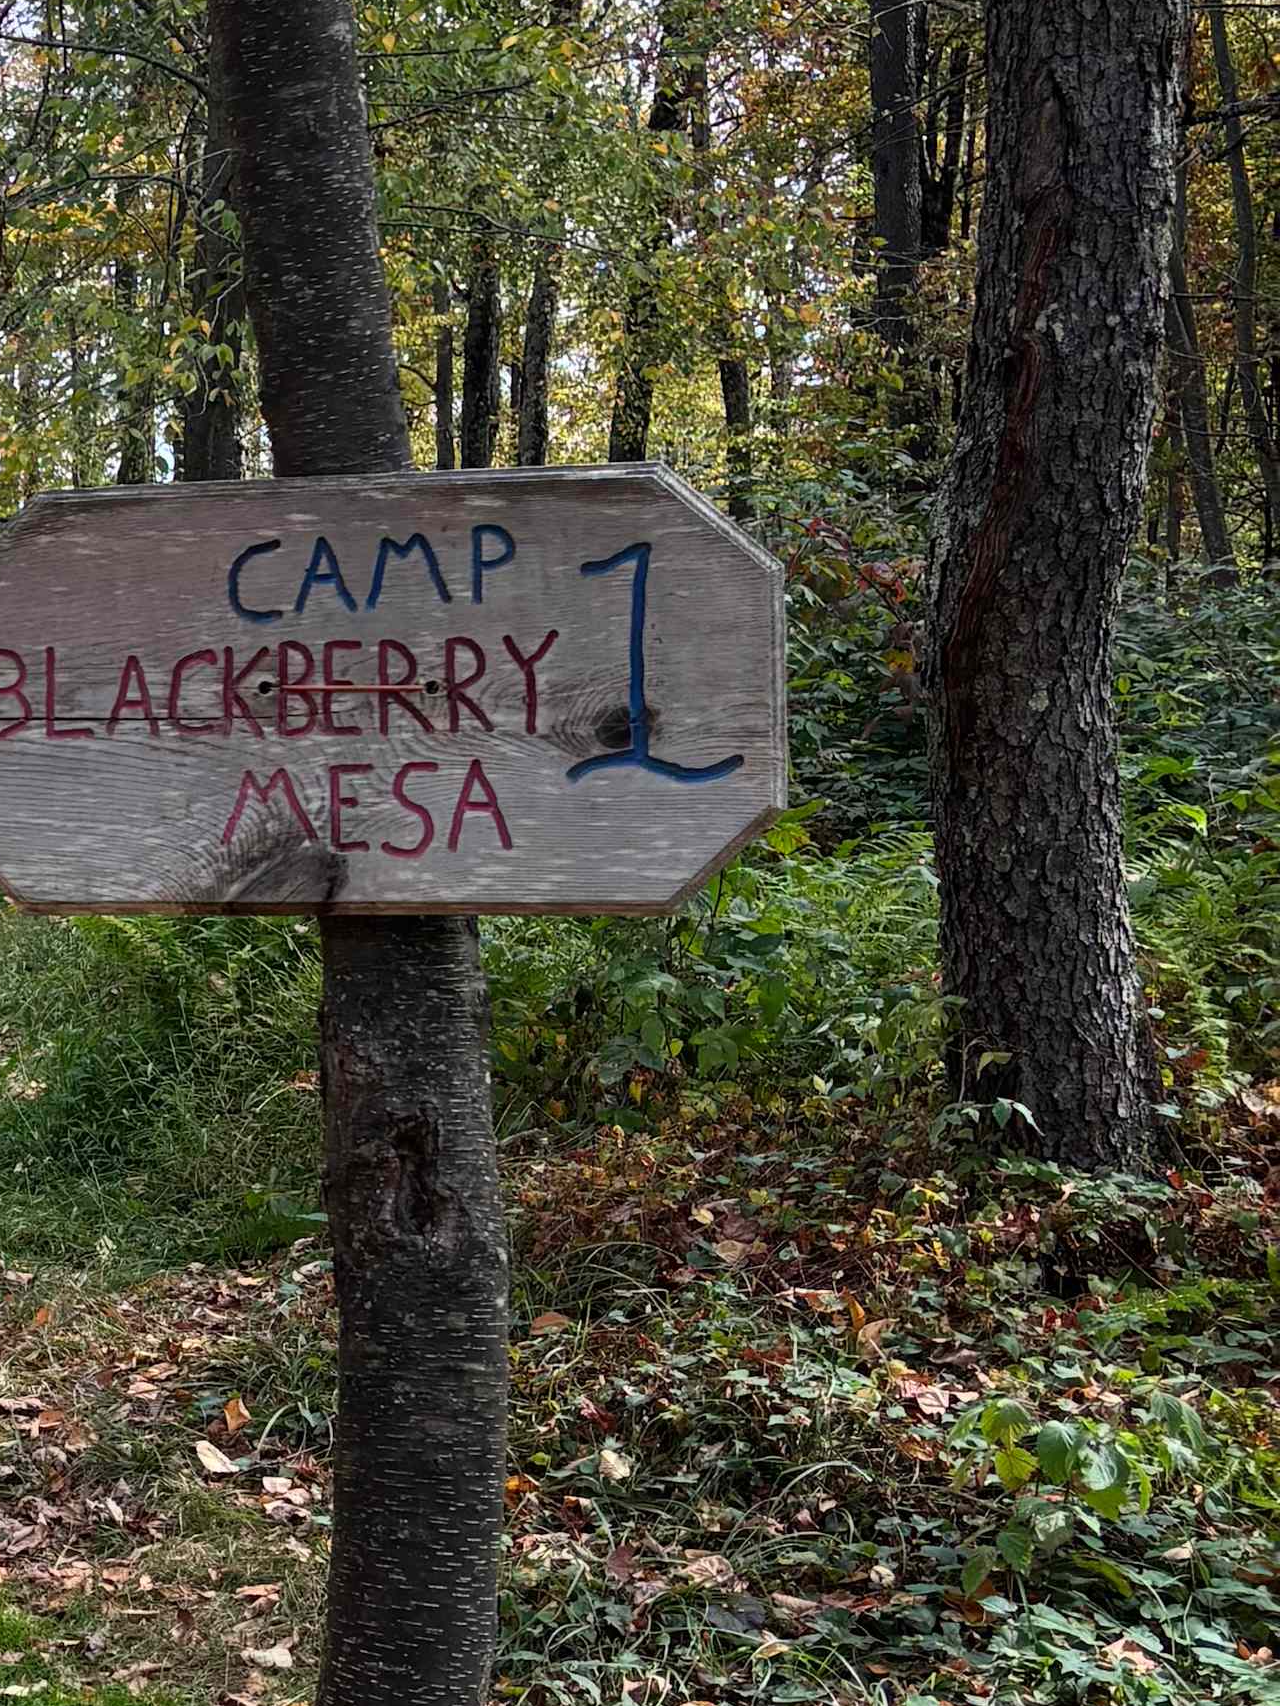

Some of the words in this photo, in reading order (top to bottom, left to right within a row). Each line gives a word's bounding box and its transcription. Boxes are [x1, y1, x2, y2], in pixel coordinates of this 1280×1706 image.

[228, 523, 517, 624] CAMP
[565, 541, 745, 784] 1
[219, 758, 513, 859] MESA
